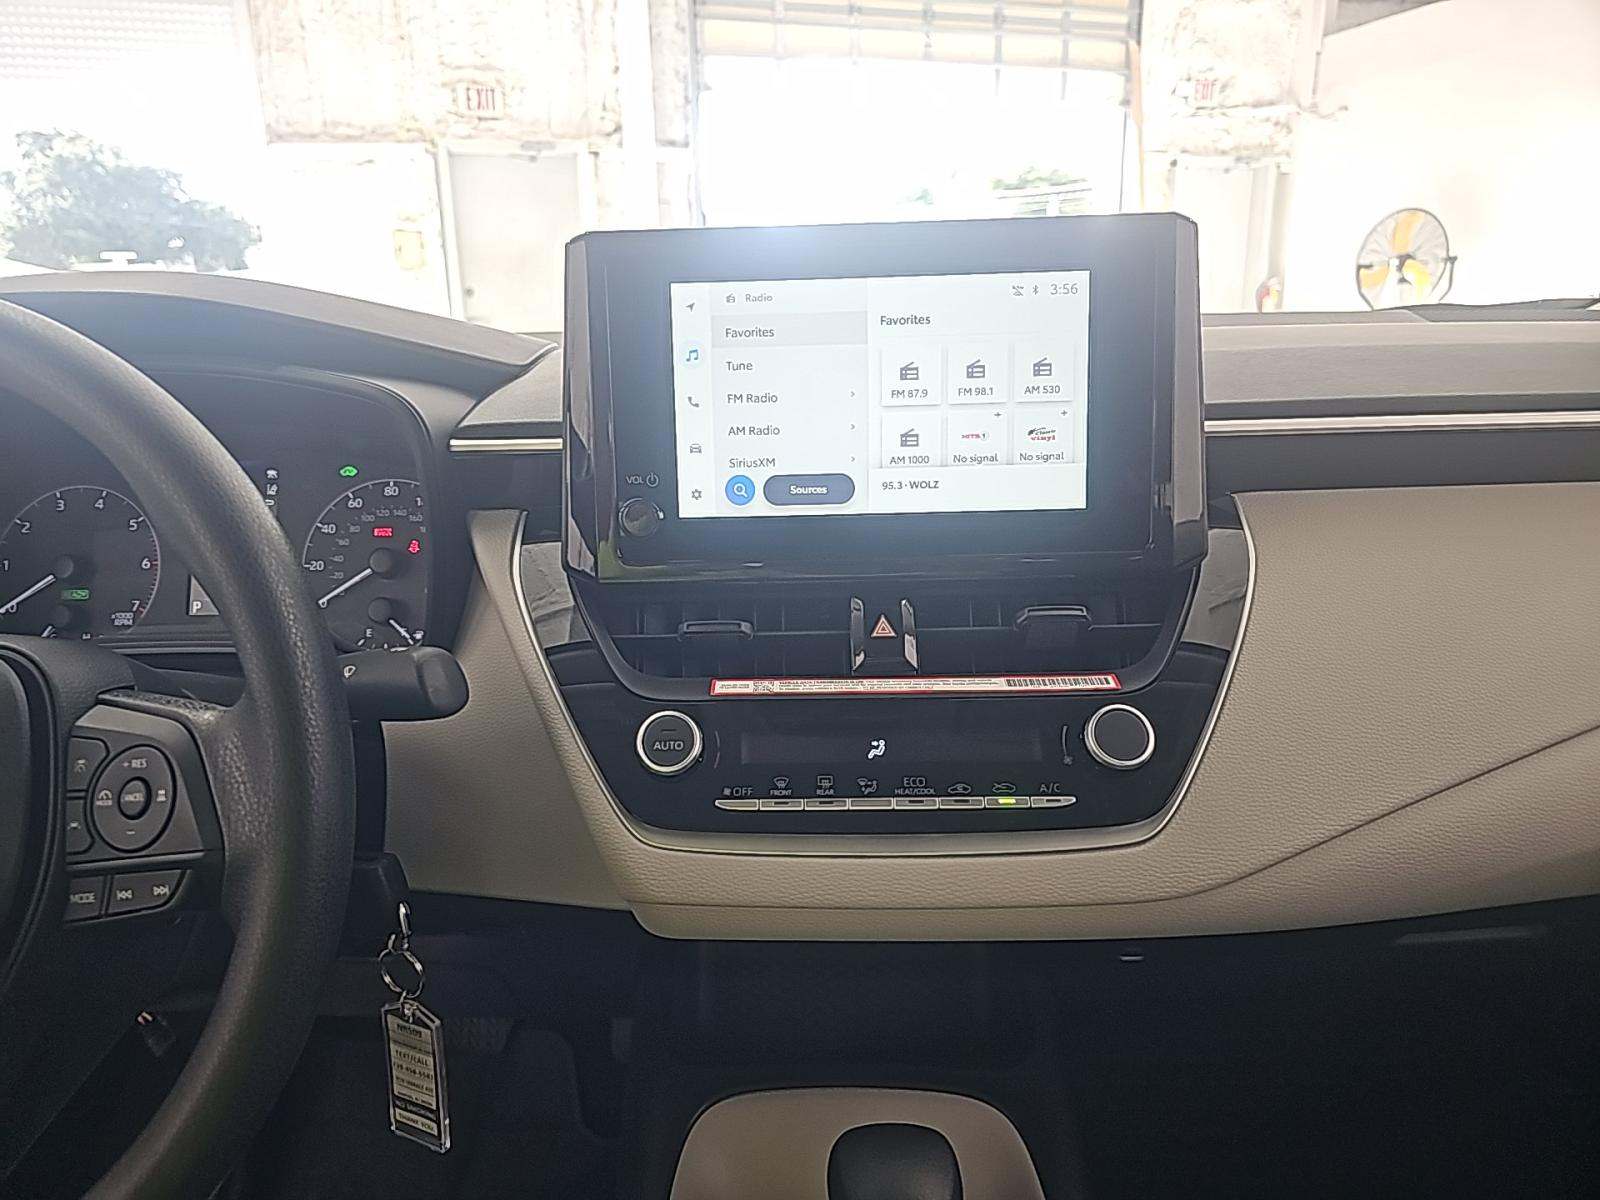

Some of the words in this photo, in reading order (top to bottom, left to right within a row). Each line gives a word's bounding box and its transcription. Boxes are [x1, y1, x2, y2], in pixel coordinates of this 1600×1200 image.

[466, 87, 496, 111] EXIT
[1050, 283, 1079, 295] 3:56
[745, 293, 773, 303] Radio
[880, 314, 931, 326] Favorites
[725, 327, 775, 338] Favorites
[726, 361, 753, 371] Tune
[891, 390, 905, 399] FM
[907, 388, 928, 398] 87.9
[958, 387, 972, 397] FM
[974, 387, 994, 396] 98.1
[1024, 385, 1040, 395] AM
[1042, 385, 1061, 394] 530
[727, 394, 743, 404] FM
[746, 393, 778, 404] Radio
[728, 426, 745, 436] AM
[748, 425, 780, 436] Radio
[889, 456, 907, 465] AM
[908, 455, 930, 464] 1000
[953, 454, 968, 463] No
[969, 453, 999, 465] signal
[1020, 452, 1034, 462] No
[1035, 451, 1065, 462] signal
[728, 457, 776, 468] SiriusXM
[625, 475, 645, 484] VOL
[789, 485, 828, 494] Sources
[909, 480, 940, 490] WOLZ
[384, 487, 399, 496] 80
[56, 500, 65, 511] 3
[95, 499, 104, 509] 4
[348, 499, 363, 508] 60
[376, 509, 390, 517] 120
[393, 508, 407, 516] 140
[361, 514, 375, 522] 100
[21, 522, 31, 533] 2
[129, 519, 138, 530] 5
[321, 524, 336, 534] 40
[3, 560, 9, 570] 1
[141, 558, 150, 569] 6
[310, 561, 325, 571] 20
[131, 600, 140, 611] 7
[192, 602, 202, 613] P
[366, 629, 373, 637] E
[653, 741, 684, 750] AUTO
[903, 777, 926, 787] ECO
[732, 788, 753, 796] OFF
[1039, 783, 1061, 793] A/C
[70, 893, 95, 903] MODE
